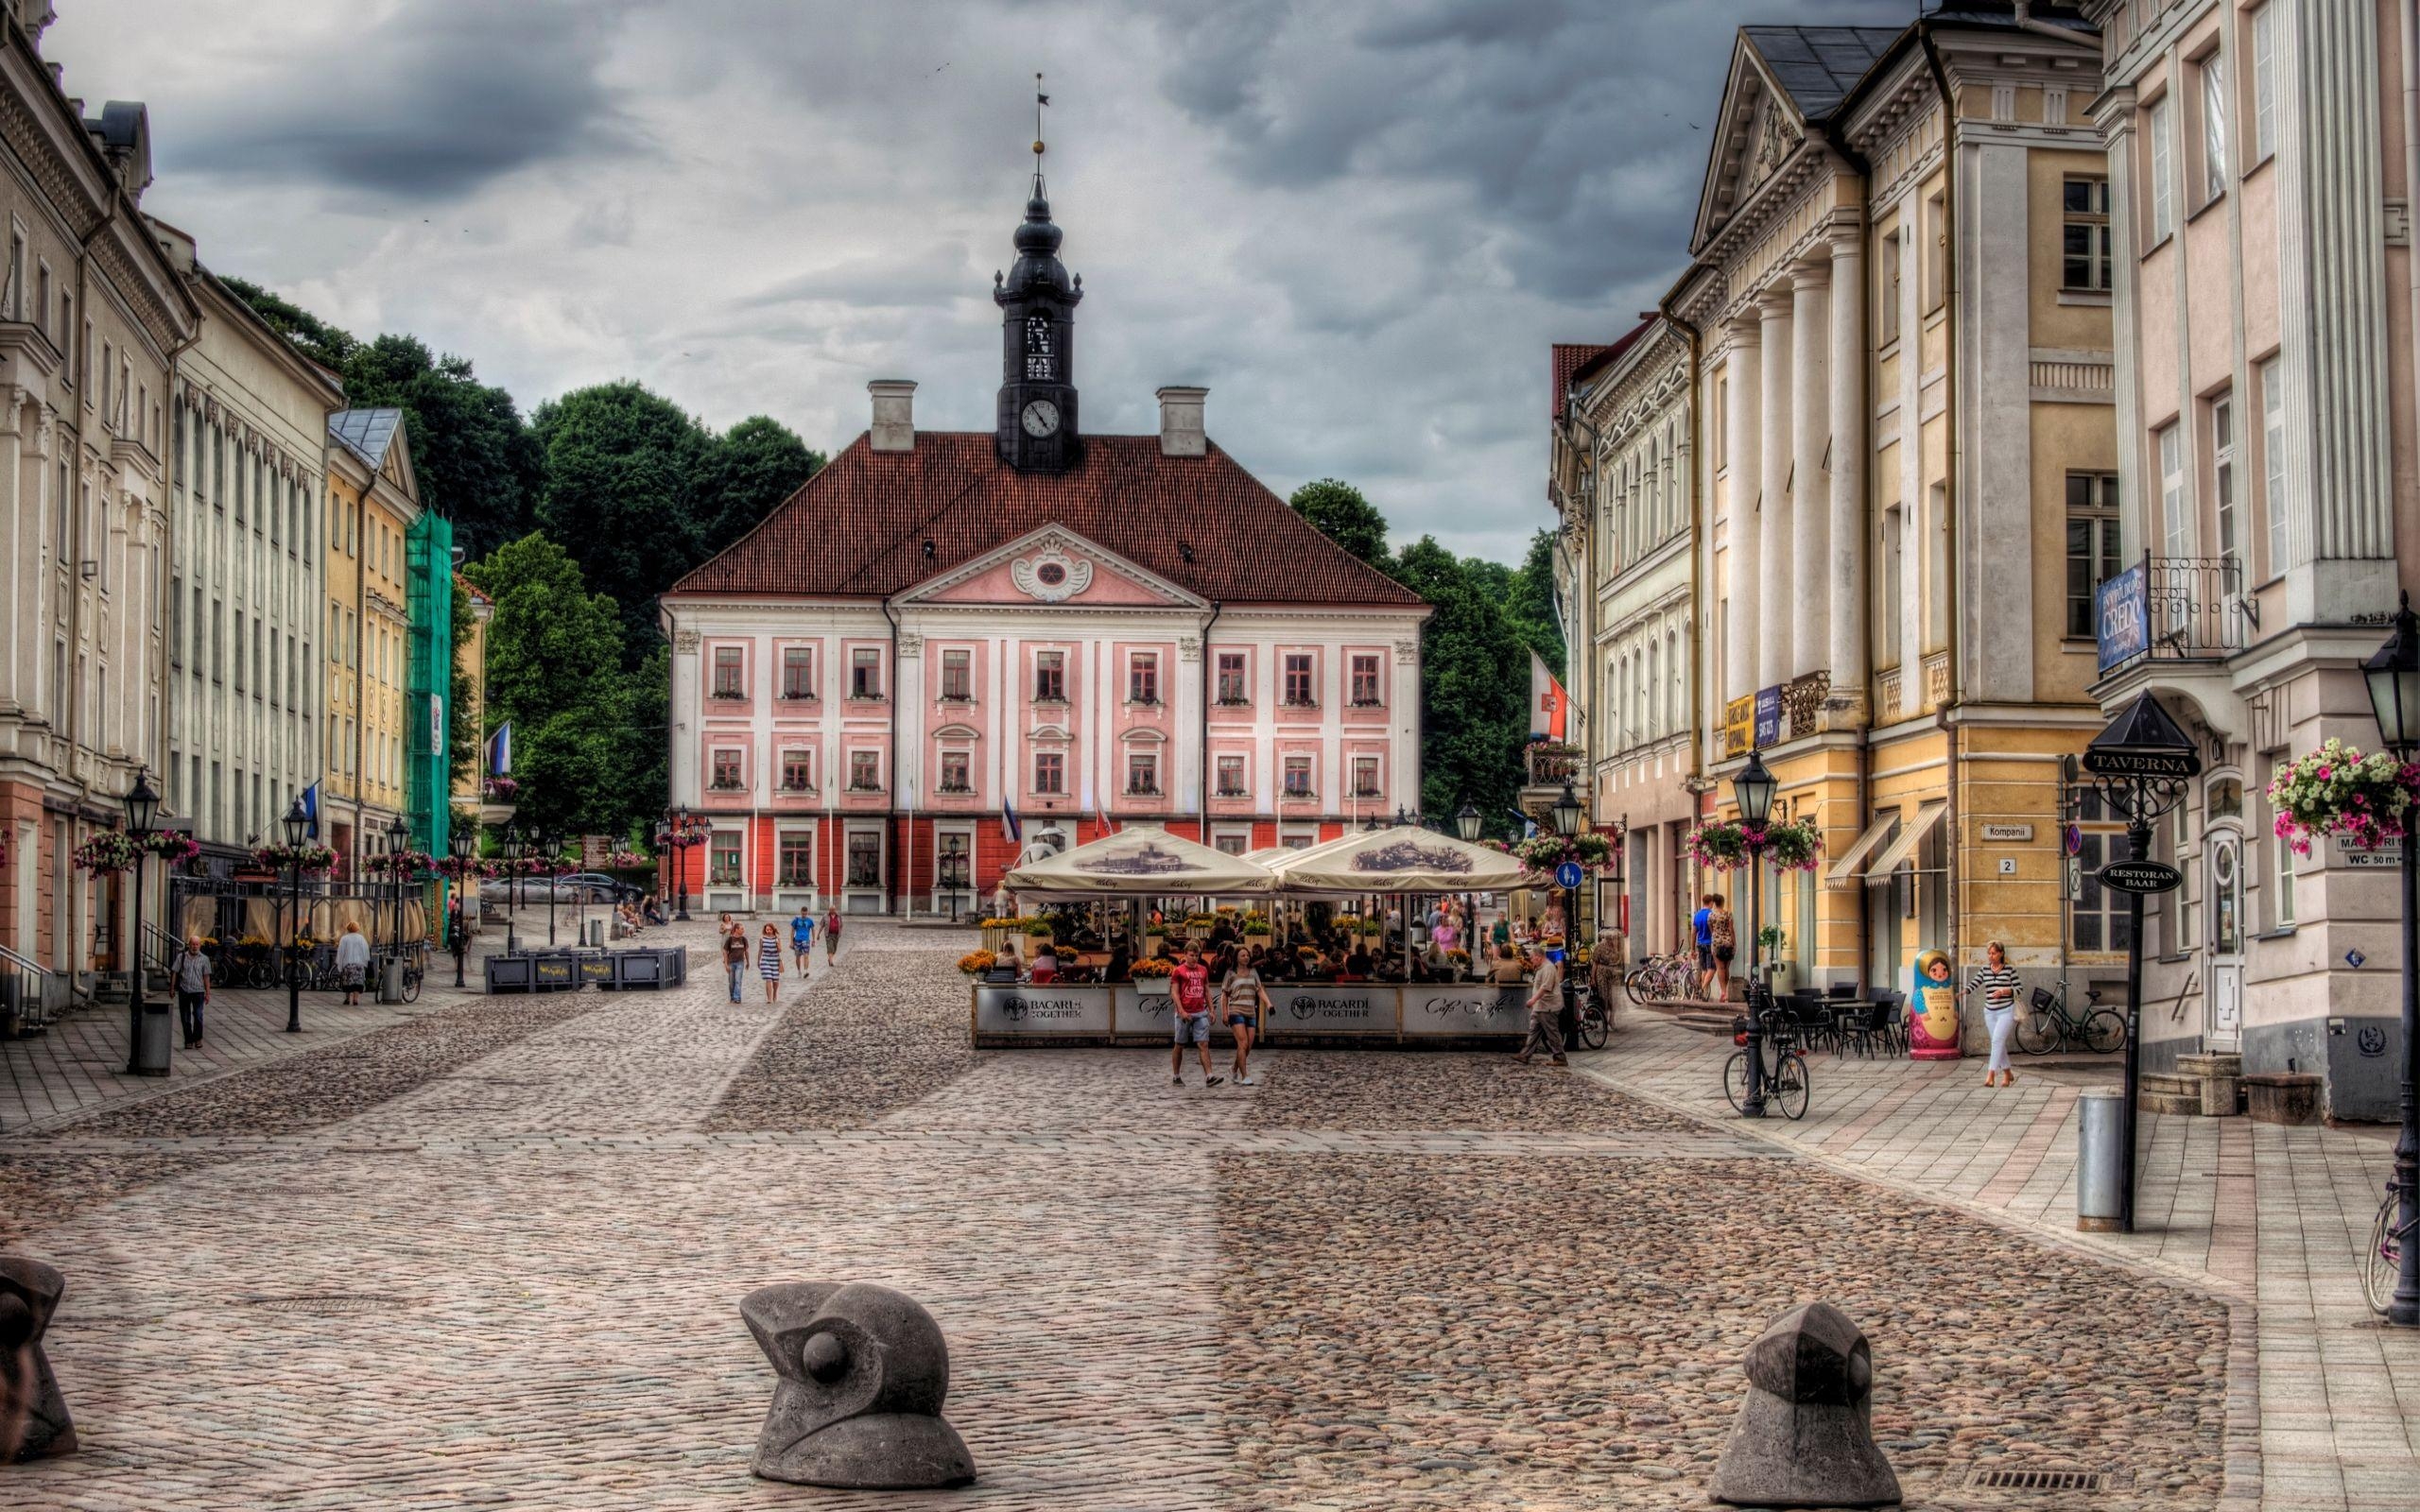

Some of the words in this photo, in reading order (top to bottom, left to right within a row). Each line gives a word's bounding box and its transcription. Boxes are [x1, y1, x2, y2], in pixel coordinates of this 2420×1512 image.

[2103, 595, 2141, 641] CREDO
[2094, 755, 2190, 772] TAVERNA
[1990, 828, 2025, 837] Kompanii
[2349, 854, 2369, 865] WC
[2374, 856, 2384, 865] 50
[2005, 861, 2011, 871] 2
[2109, 868, 2174, 880] RESTORAN
[2125, 879, 2157, 887] BAAR
